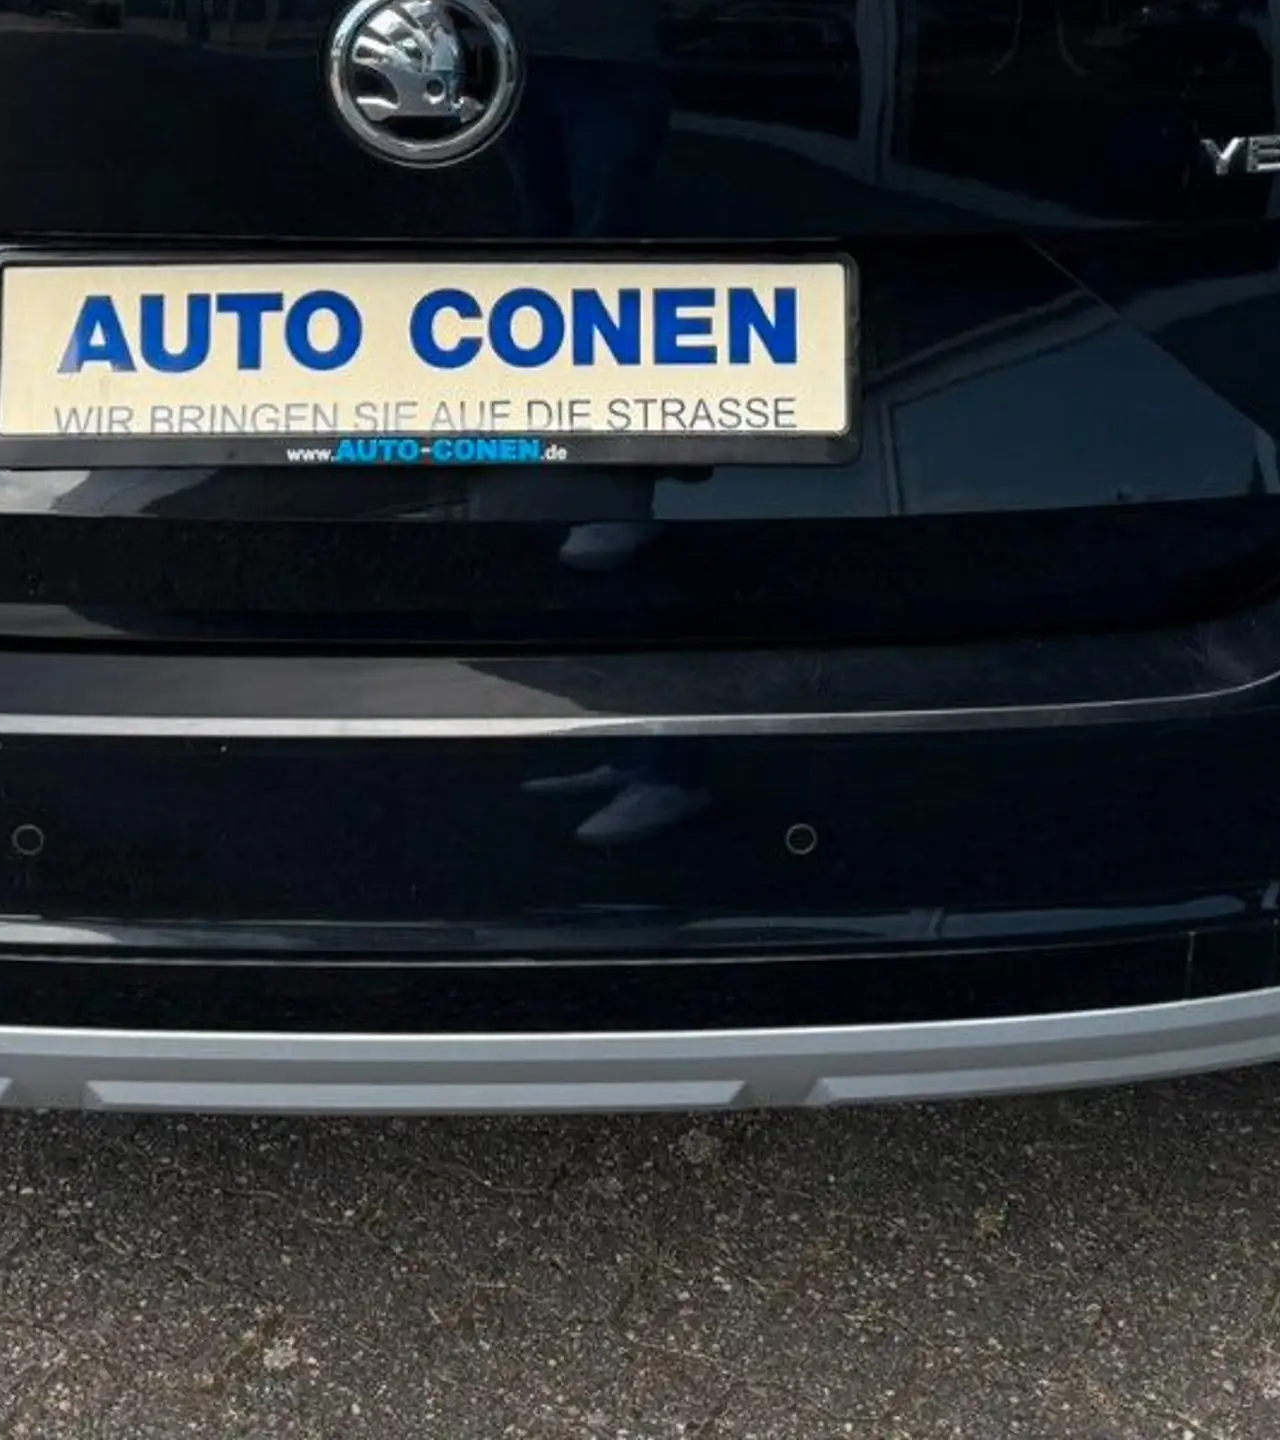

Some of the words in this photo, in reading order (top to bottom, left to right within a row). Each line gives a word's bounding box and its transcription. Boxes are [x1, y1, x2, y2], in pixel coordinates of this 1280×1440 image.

[57, 289, 363, 375] AUTO
[409, 286, 797, 370] CONEN
[54, 404, 135, 436] WIR
[149, 402, 340, 435] BRINGEN
[354, 401, 420, 434] SIE
[431, 400, 512, 431] AUF
[526, 398, 592, 431] DIE
[606, 396, 798, 430] STRASSE
[286, 438, 568, 463] www.AUTO-CONEN.de
